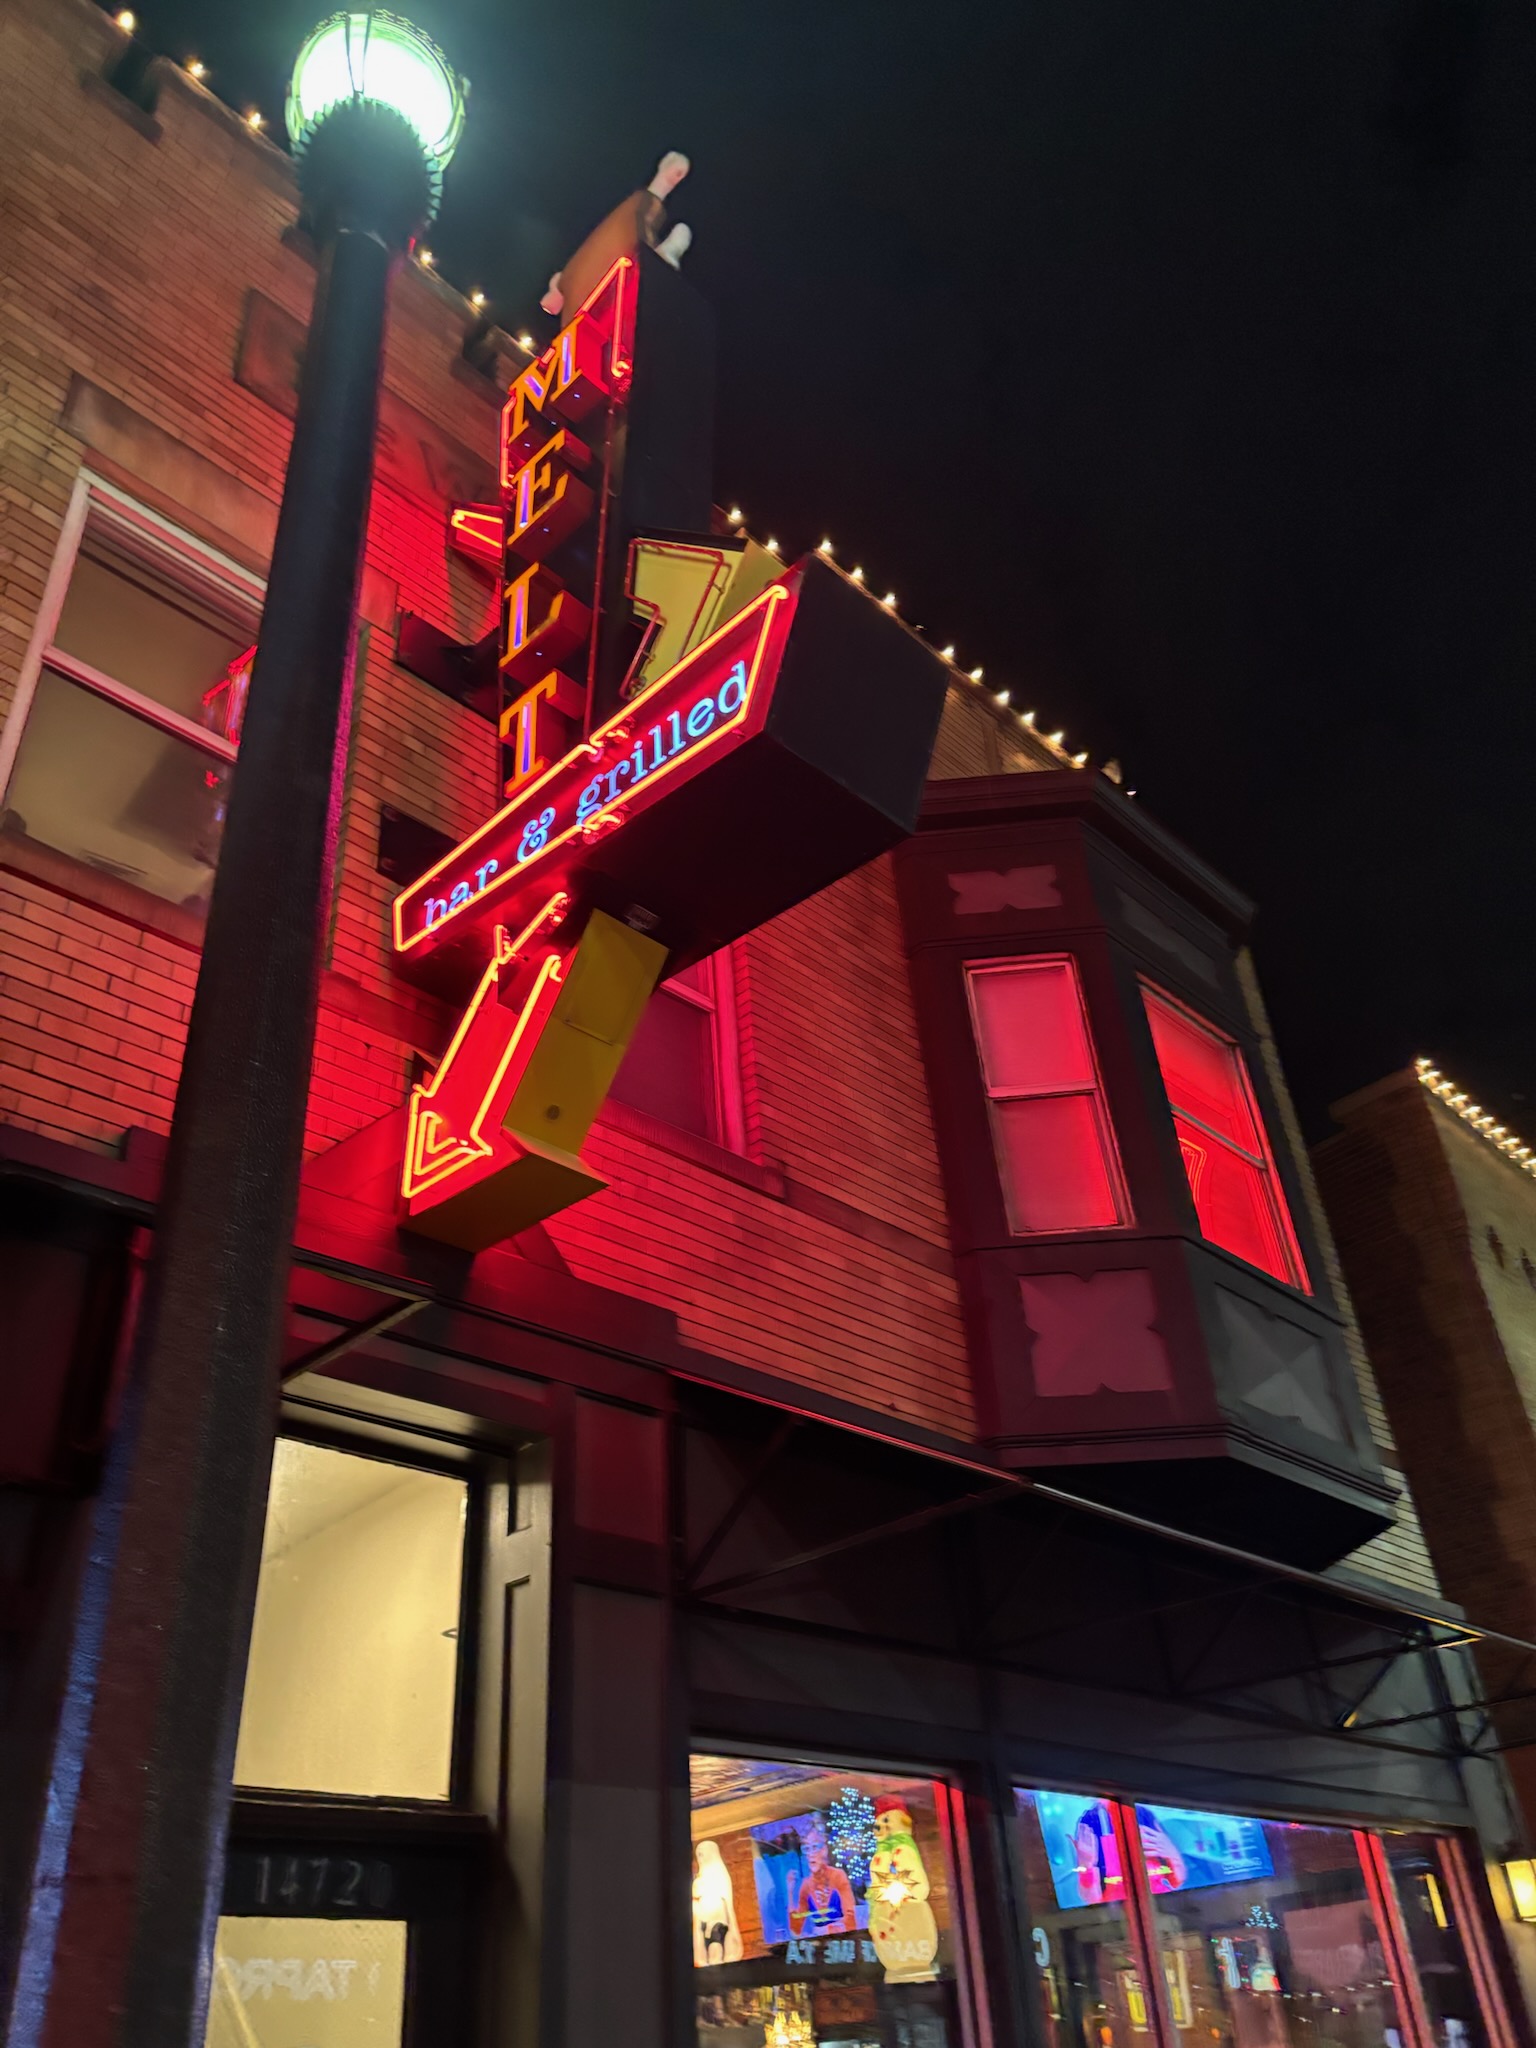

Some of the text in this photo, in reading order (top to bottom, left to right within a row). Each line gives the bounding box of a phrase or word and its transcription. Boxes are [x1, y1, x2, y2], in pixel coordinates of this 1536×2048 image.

[499, 314, 586, 798] MELT
[517, 807, 556, 863] &
[576, 660, 748, 829] grilled
